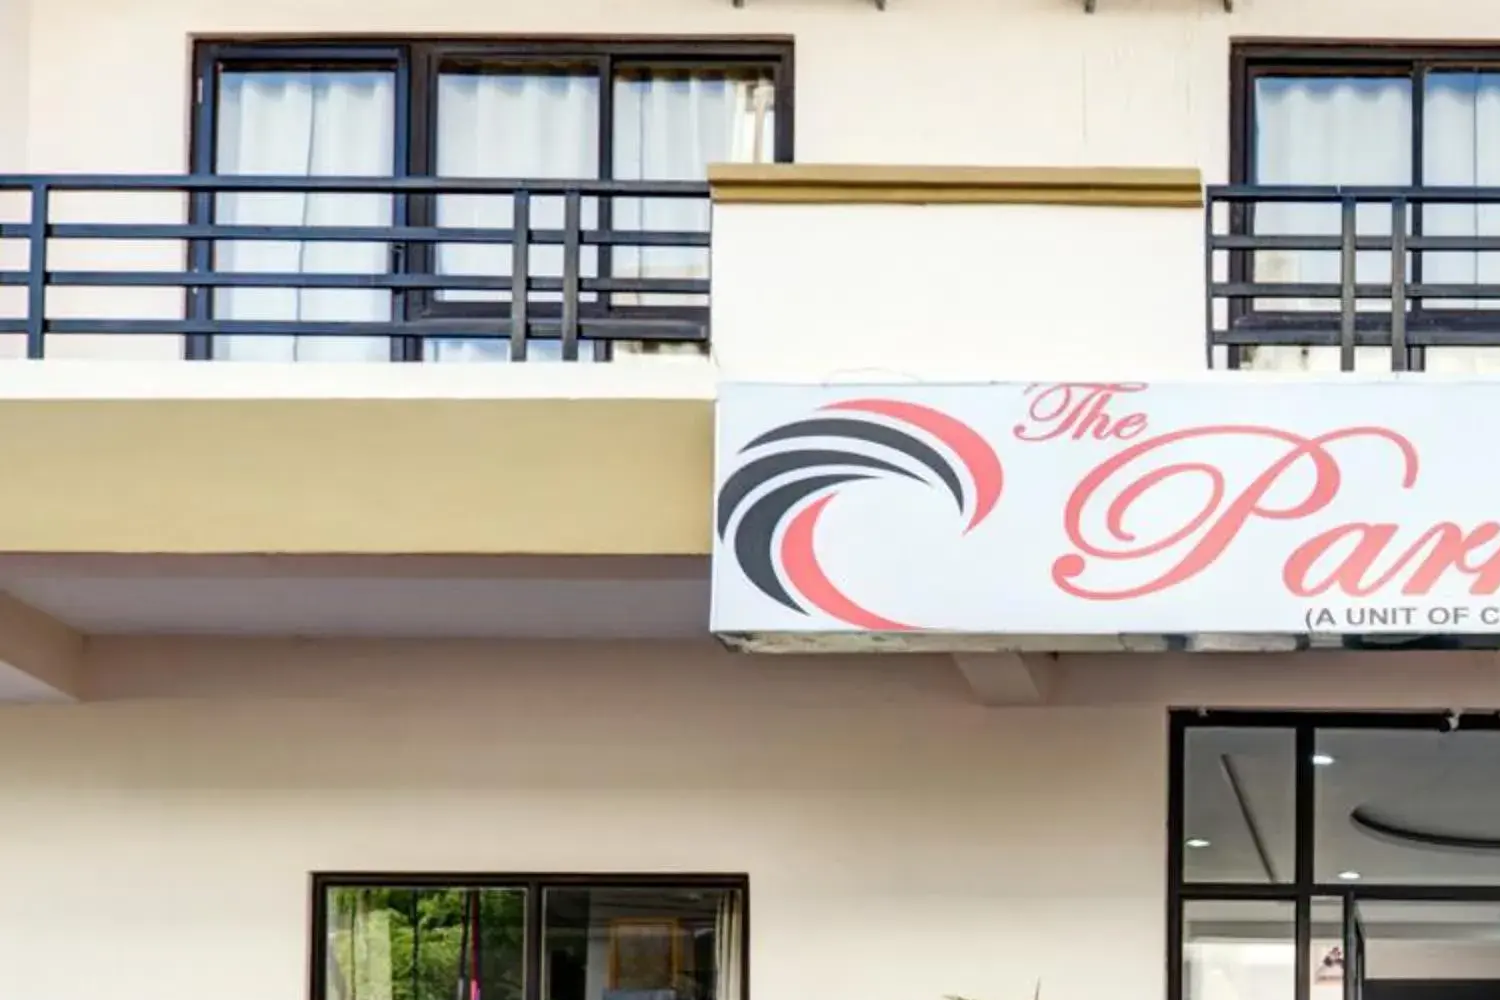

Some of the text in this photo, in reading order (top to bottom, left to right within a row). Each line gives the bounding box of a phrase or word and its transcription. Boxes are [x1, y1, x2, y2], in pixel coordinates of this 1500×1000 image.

[1012, 381, 1150, 441] The
[1304, 606, 1336, 630] (A
[1345, 606, 1418, 626] UNIT
[1427, 605, 1470, 626] OF
